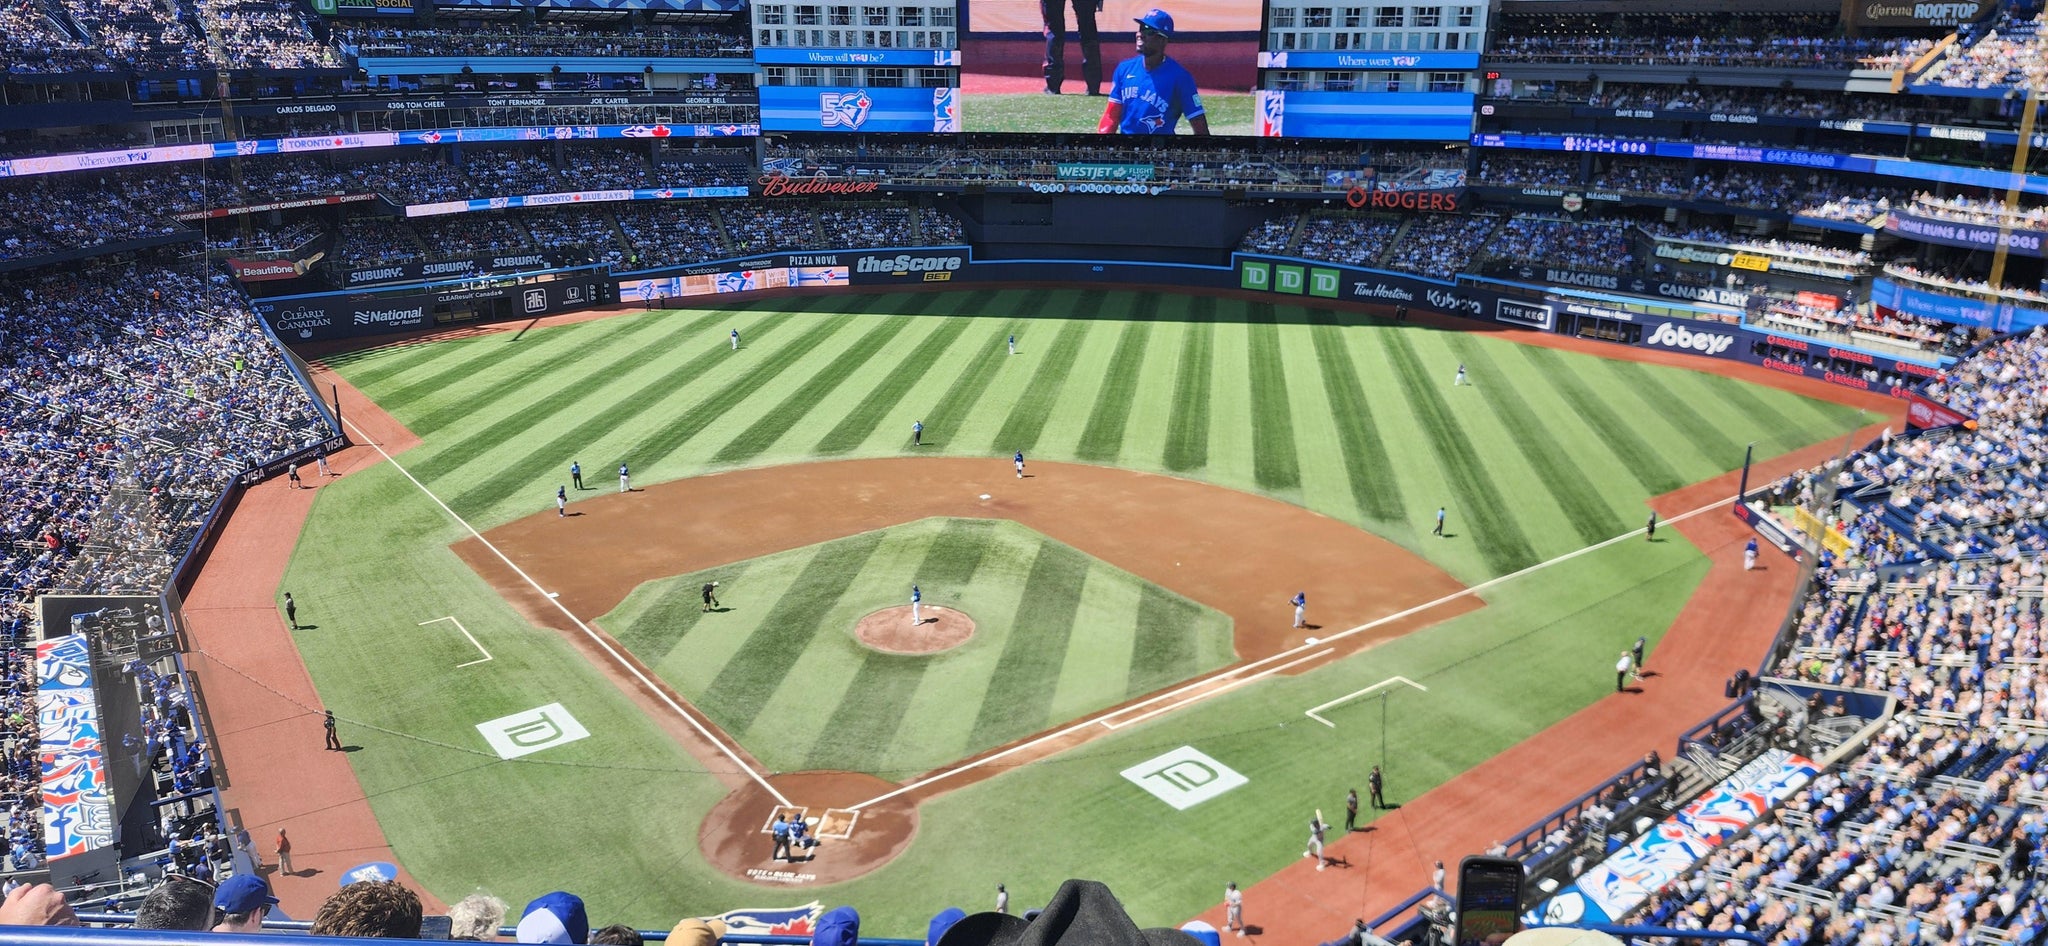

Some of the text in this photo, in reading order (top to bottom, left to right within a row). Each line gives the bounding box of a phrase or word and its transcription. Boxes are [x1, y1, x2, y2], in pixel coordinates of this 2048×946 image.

[1866, 3, 1979, 19] Corona ROOFTOP
[809, 53, 884, 62] Where will YOU be?
[1338, 56, 1421, 66] Where were YOU?
[1121, 86, 1168, 113] LUE JAYS
[277, 105, 336, 114] CARLOS DELGADO
[288, 138, 332, 149] TORONTO
[77, 155, 105, 168] Where
[107, 154, 127, 165] were
[1058, 167, 1112, 179] WESTJET
[757, 175, 878, 196] Budweiser
[1033, 182, 1148, 195] VOTE BLUE JAYS
[1522, 188, 1549, 196] CANADA
[532, 195, 571, 204] TORONTO
[603, 192, 624, 200] JAYS
[1371, 189, 1456, 211] ROGERS
[1586, 192, 1621, 201] BLEACHERS
[249, 204, 271, 213] OWNER
[280, 200, 311, 209] CANADA'S
[311, 198, 327, 206] TEAM
[1899, 218, 2040, 250] HOME RUNS & HOT DOGS
[492, 255, 544, 268] SUBWAY
[789, 255, 838, 266] PIZZA NOVA
[857, 255, 961, 273] theScore
[1656, 244, 1769, 270] theScore BET
[244, 266, 294, 277] BeautiTone
[350, 266, 404, 282] SUBWAY
[422, 260, 475, 274] SUBWAY
[1245, 267, 1267, 284] TD
[1279, 270, 1300, 288] TD
[1314, 273, 1336, 292] TD
[1546, 269, 1618, 290] BLEACHERS
[475, 290, 499, 298] Canada
[1659, 282, 1718, 303] CANADA
[1719, 291, 1749, 307] DRY
[260, 305, 275, 313] 328
[281, 308, 325, 321] CLEARLY
[370, 306, 422, 322] National
[1503, 305, 1545, 321] THE KEG
[277, 316, 331, 331] CANADIAN
[389, 318, 421, 327] Car Rental
[1647, 322, 1734, 355] Sobeys
[1774, 337, 1808, 351] ROGERS
[1838, 350, 1873, 364] ROGERS
[1771, 360, 1804, 375] ROGERS
[1835, 374, 1868, 389] ROGERS
[325, 437, 344, 452] VISA
[243, 468, 265, 484] VISA
[503, 711, 563, 747] TD
[1142, 760, 1219, 792] TD
